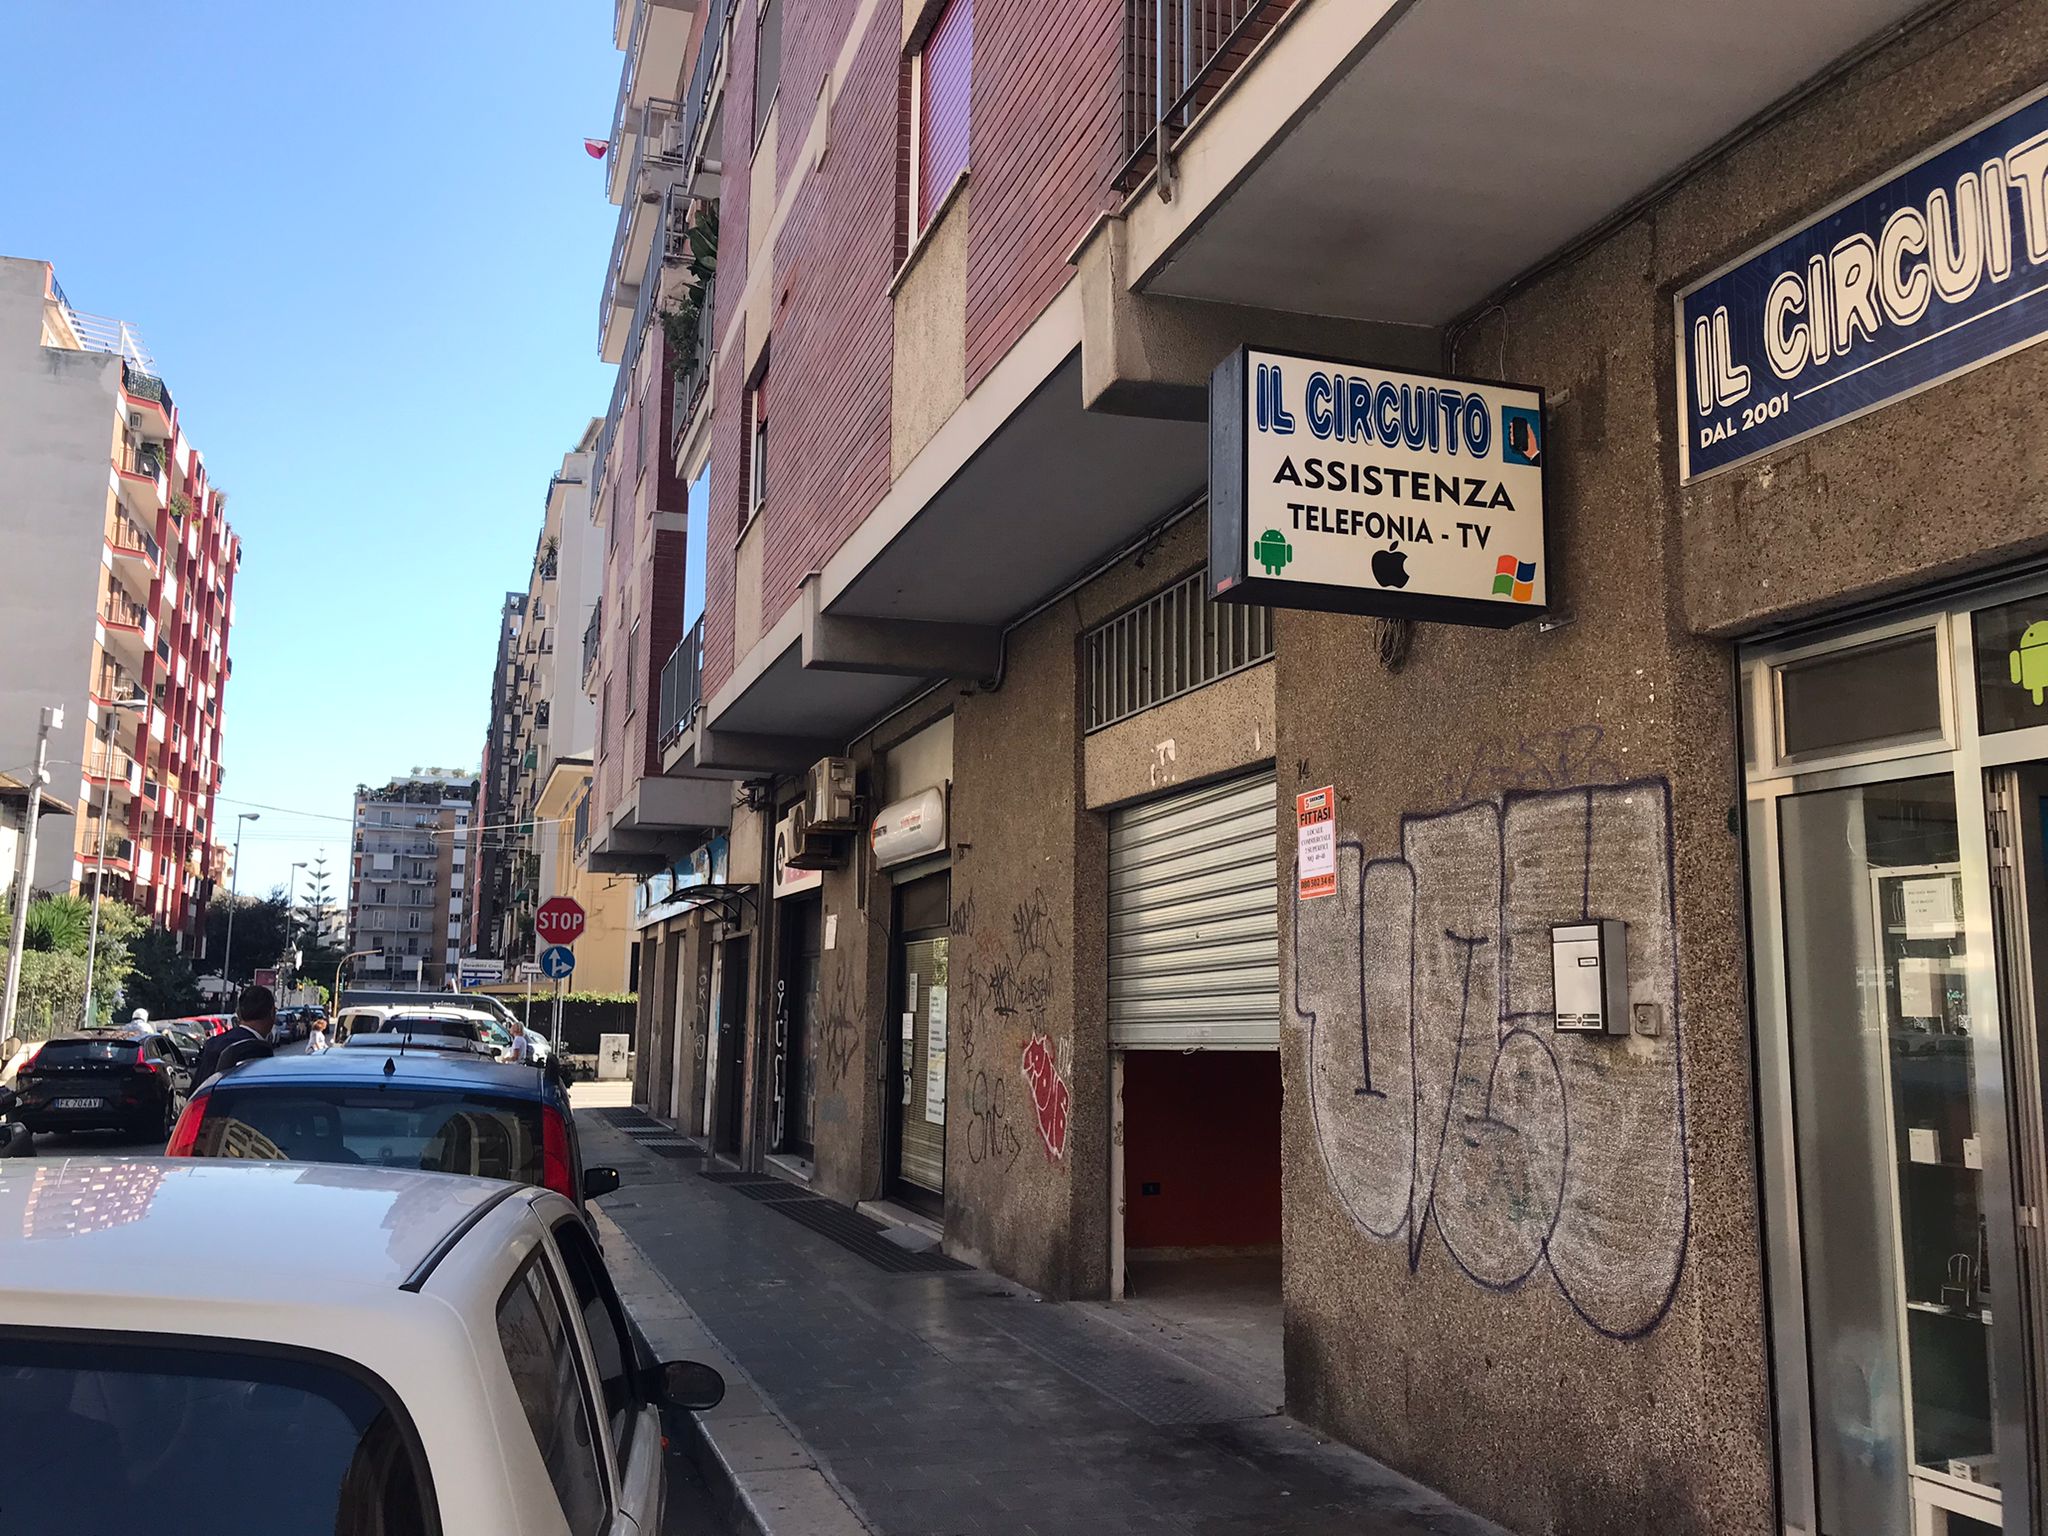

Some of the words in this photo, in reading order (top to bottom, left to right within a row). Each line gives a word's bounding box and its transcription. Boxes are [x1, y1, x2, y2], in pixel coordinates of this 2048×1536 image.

[1695, 305, 1751, 417] IL
[1256, 363, 1295, 435] IL
[1305, 371, 1491, 459] CIRCUITO
[1700, 416, 1737, 449] DAL
[1741, 392, 1790, 433] 2001
[1273, 455, 1516, 512] ASSISTENZA
[1287, 503, 1433, 545] TELEFONIA
[1456, 522, 1492, 551] TV
[1300, 806, 1331, 826] FITTASI
[538, 912, 583, 930] STOP
